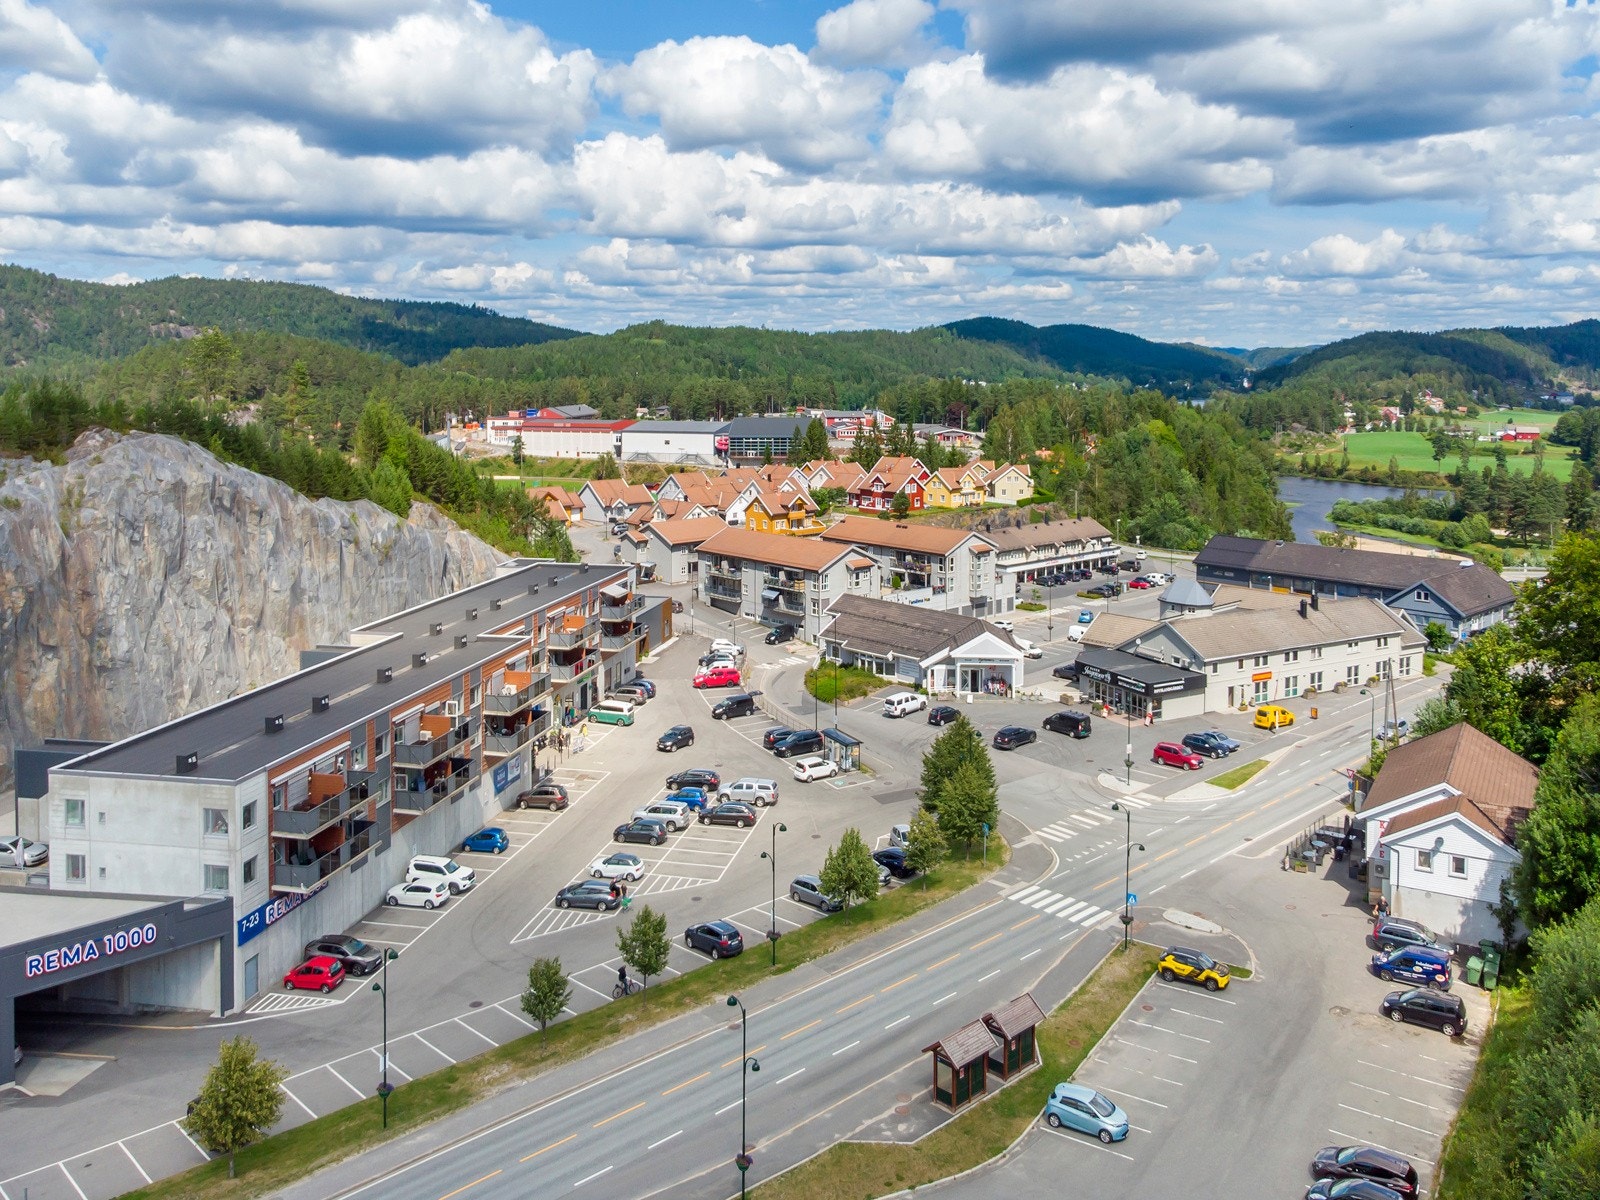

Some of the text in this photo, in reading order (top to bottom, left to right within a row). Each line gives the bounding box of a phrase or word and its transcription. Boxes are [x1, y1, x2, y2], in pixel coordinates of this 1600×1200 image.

[242, 912, 260, 933] 7-23
[26, 923, 156, 977] REMA 1000
